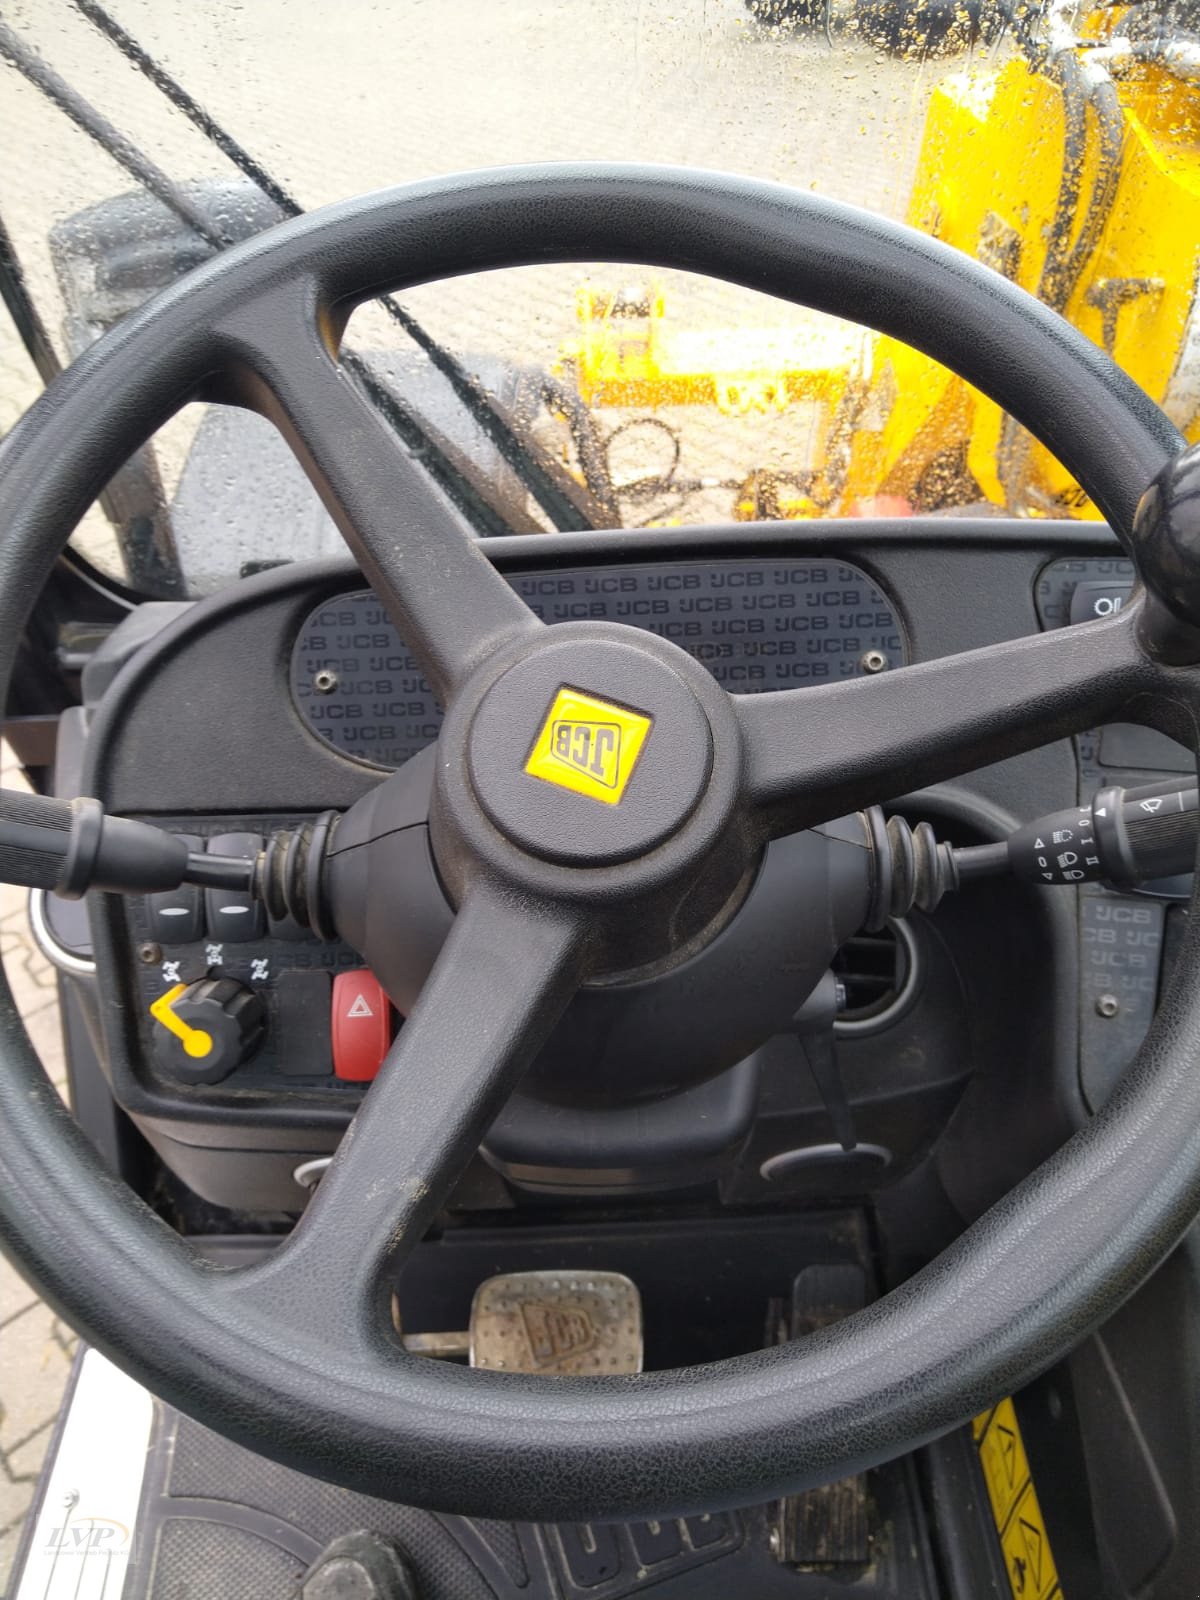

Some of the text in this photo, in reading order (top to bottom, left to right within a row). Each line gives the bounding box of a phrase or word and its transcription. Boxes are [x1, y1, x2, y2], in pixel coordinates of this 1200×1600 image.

[1097, 562, 1133, 574] JC
[522, 580, 575, 596] JCB
[585, 577, 638, 594] JCB
[648, 574, 701, 591] JCB
[711, 571, 764, 588] JCB
[774, 568, 828, 585] JCB
[554, 602, 607, 618] JCB
[616, 599, 669, 616] JCB
[680, 597, 733, 613] JCB
[743, 594, 796, 610] JCB
[806, 590, 860, 607] JCB
[711, 619, 765, 635] JCB
[775, 616, 829, 632] JCB
[839, 612, 893, 629] JCB
[337, 633, 390, 649] JCB
[744, 640, 797, 657] JCB
[807, 637, 861, 653] JCB
[871, 636, 901, 650] JC
[713, 665, 765, 681] JCB
[776, 662, 829, 678] JCB
[340, 679, 432, 695] JCB JC
[310, 704, 362, 719] JCB
[373, 701, 425, 717] JCB
[344, 726, 396, 741] JCB
[407, 724, 440, 739] JC
[557, 725, 614, 776] JCB
[1095, 905, 1151, 924] JCB
[1082, 927, 1159, 947] CB JC
[1091, 950, 1146, 969] JCB
